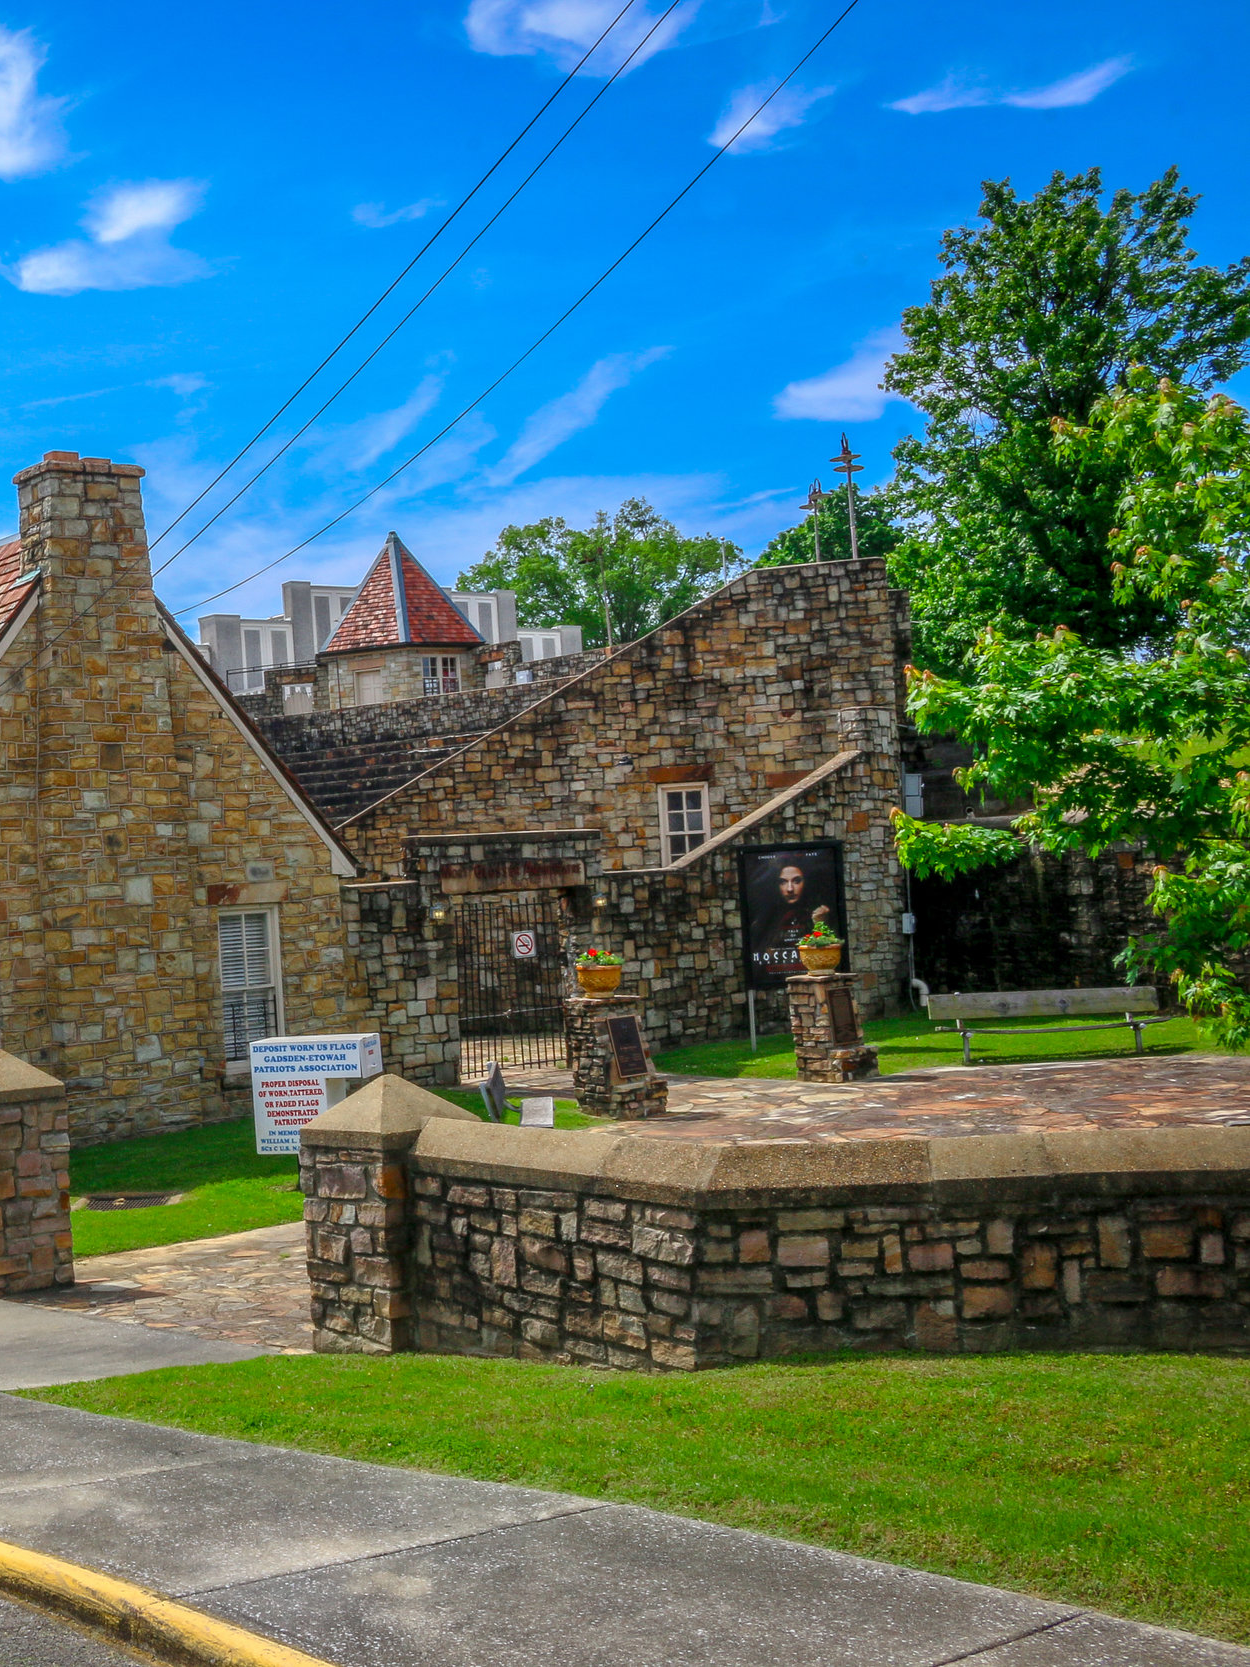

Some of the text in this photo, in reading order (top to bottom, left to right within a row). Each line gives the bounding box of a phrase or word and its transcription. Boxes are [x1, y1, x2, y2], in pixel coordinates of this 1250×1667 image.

[252, 1045, 288, 1053] DEPOSIT
[289, 1044, 315, 1052] WORN
[316, 1043, 328, 1051] US
[330, 1042, 357, 1051] FLAGS
[263, 1053, 346, 1063] GADSDEN-ETOWAH
[253, 1063, 358, 1073] PATRIOTS ASSOCIATION
[287, 1079, 320, 1087] DISPOSAL
[258, 1090, 267, 1098] OF
[297, 1099, 320, 1107] FLAGS
[267, 1109, 319, 1118] DEMONSTRATES
